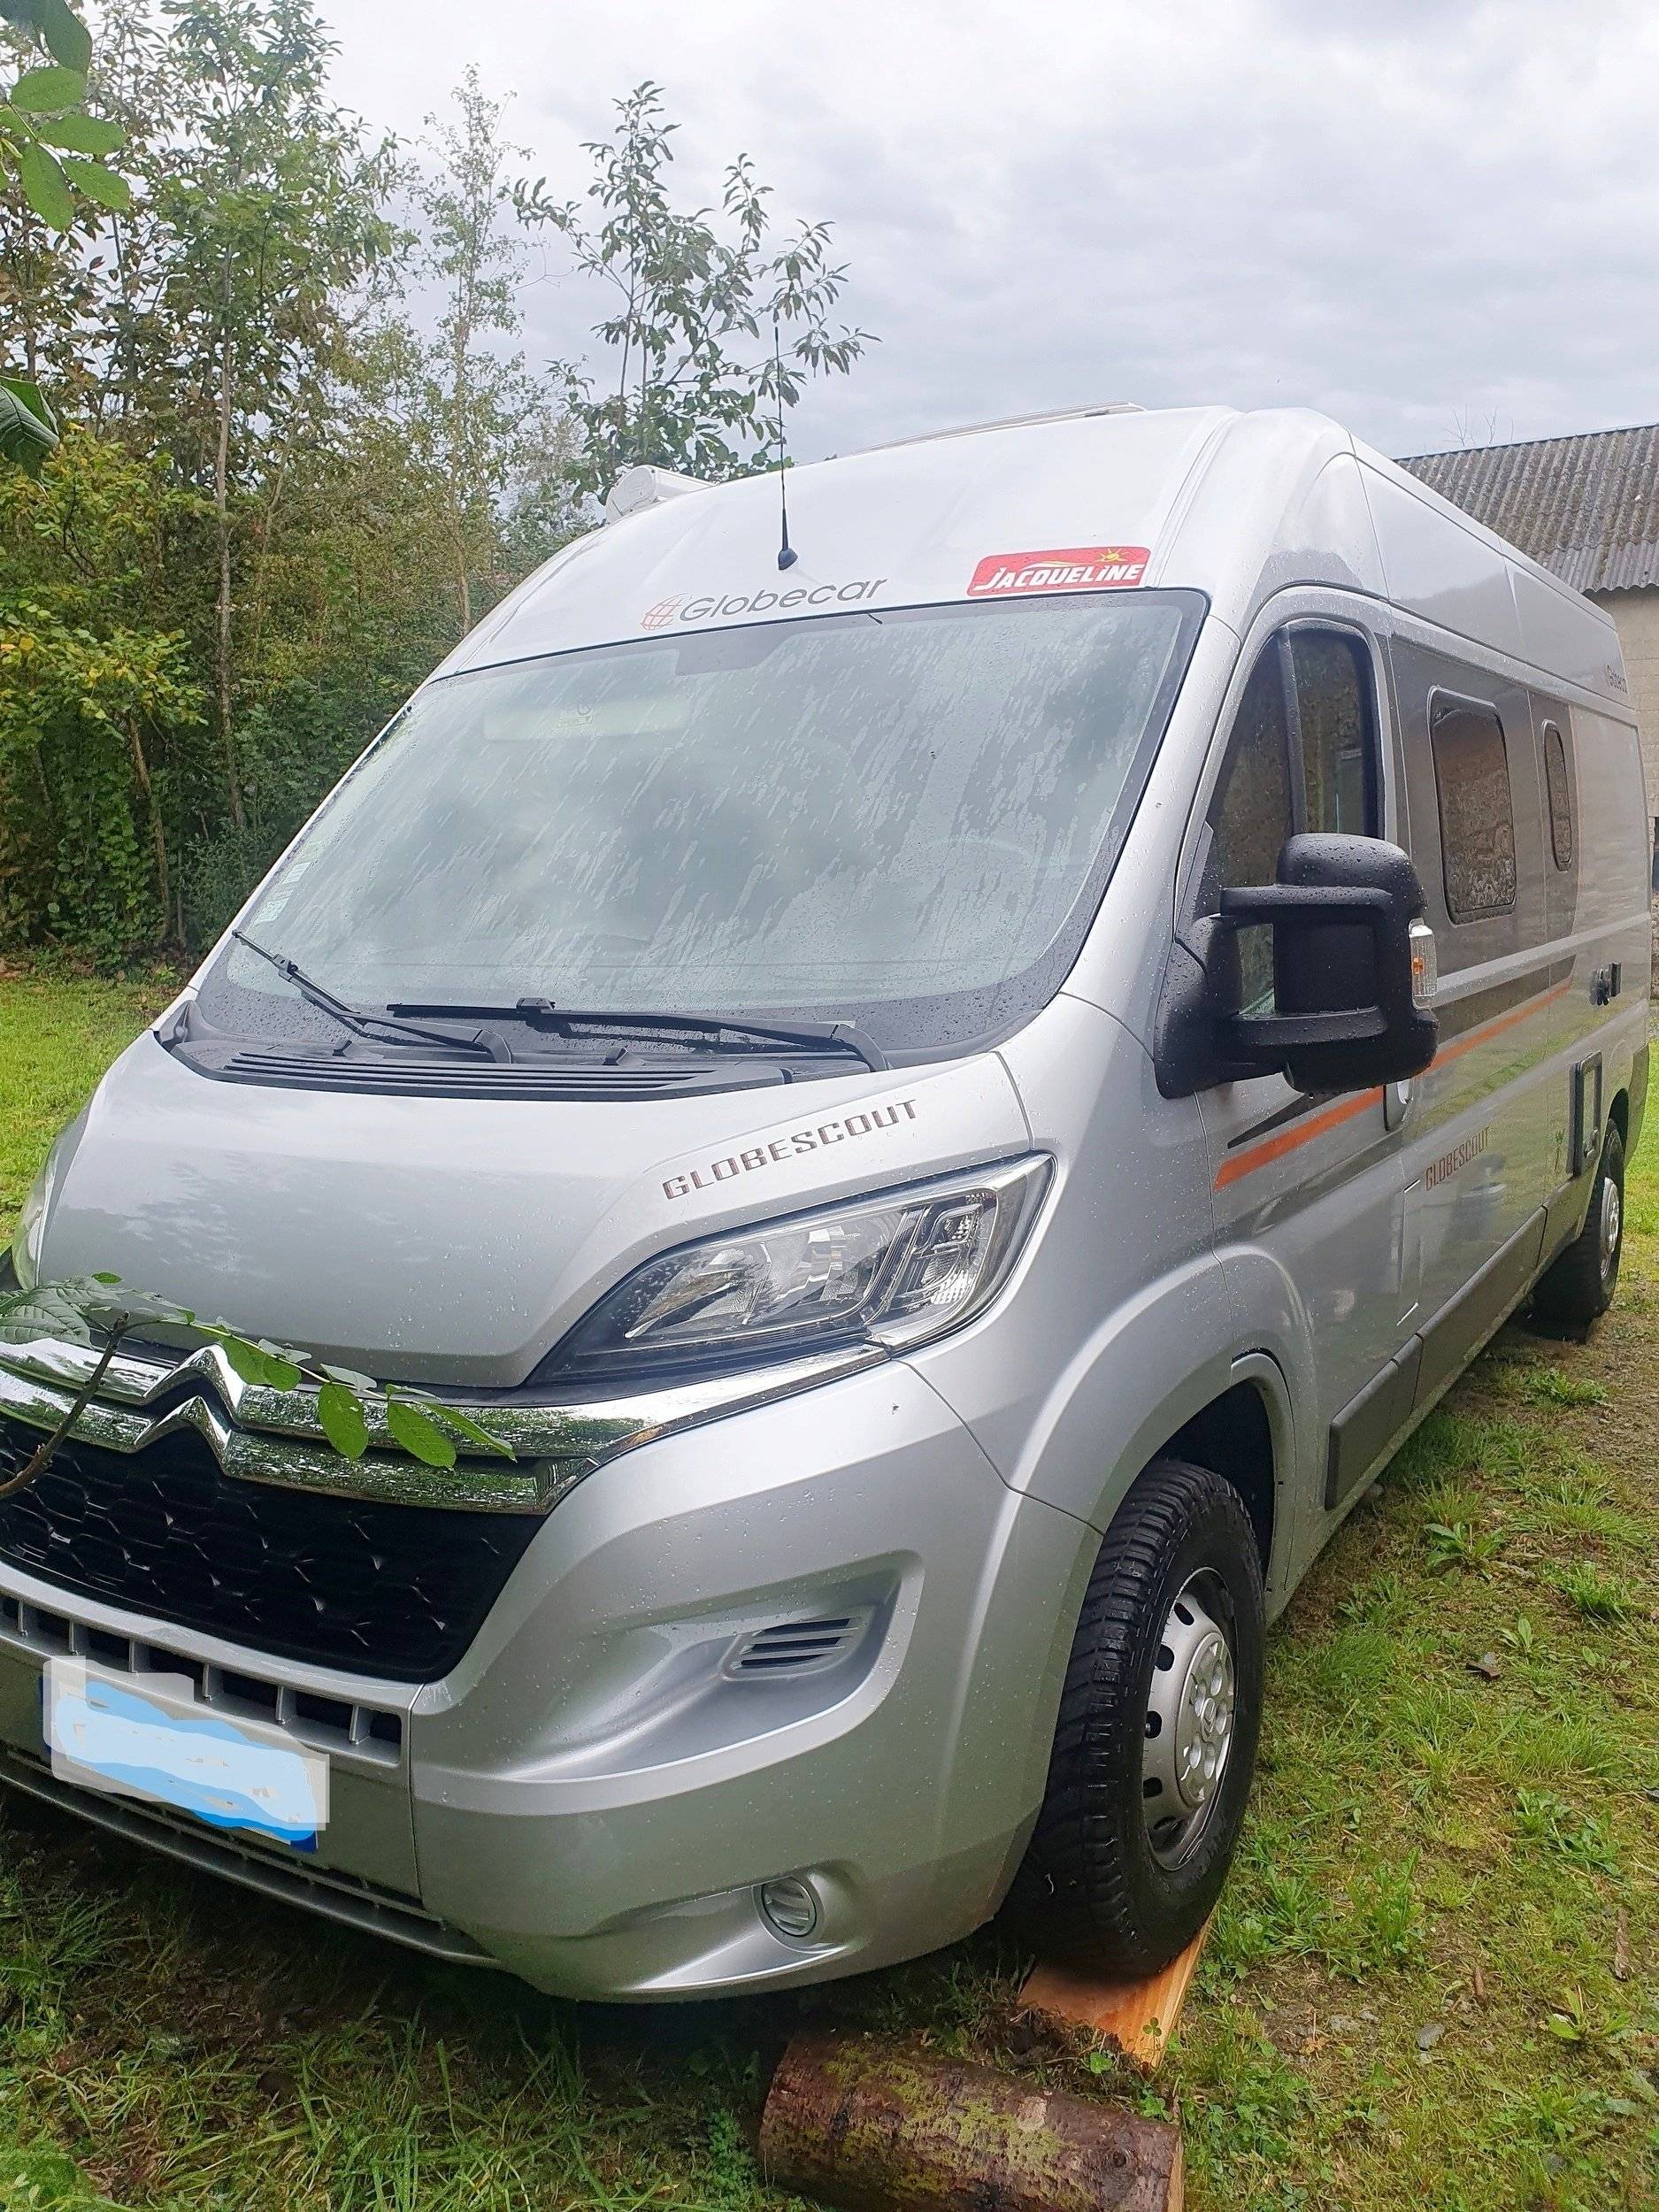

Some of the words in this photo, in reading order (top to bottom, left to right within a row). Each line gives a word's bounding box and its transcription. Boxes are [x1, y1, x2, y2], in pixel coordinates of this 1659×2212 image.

[680, 578, 887, 621] Globecar
[662, 1099, 917, 1200] GLOBESCOUT
[1425, 1125, 1489, 1192] GLOBESCOUT
